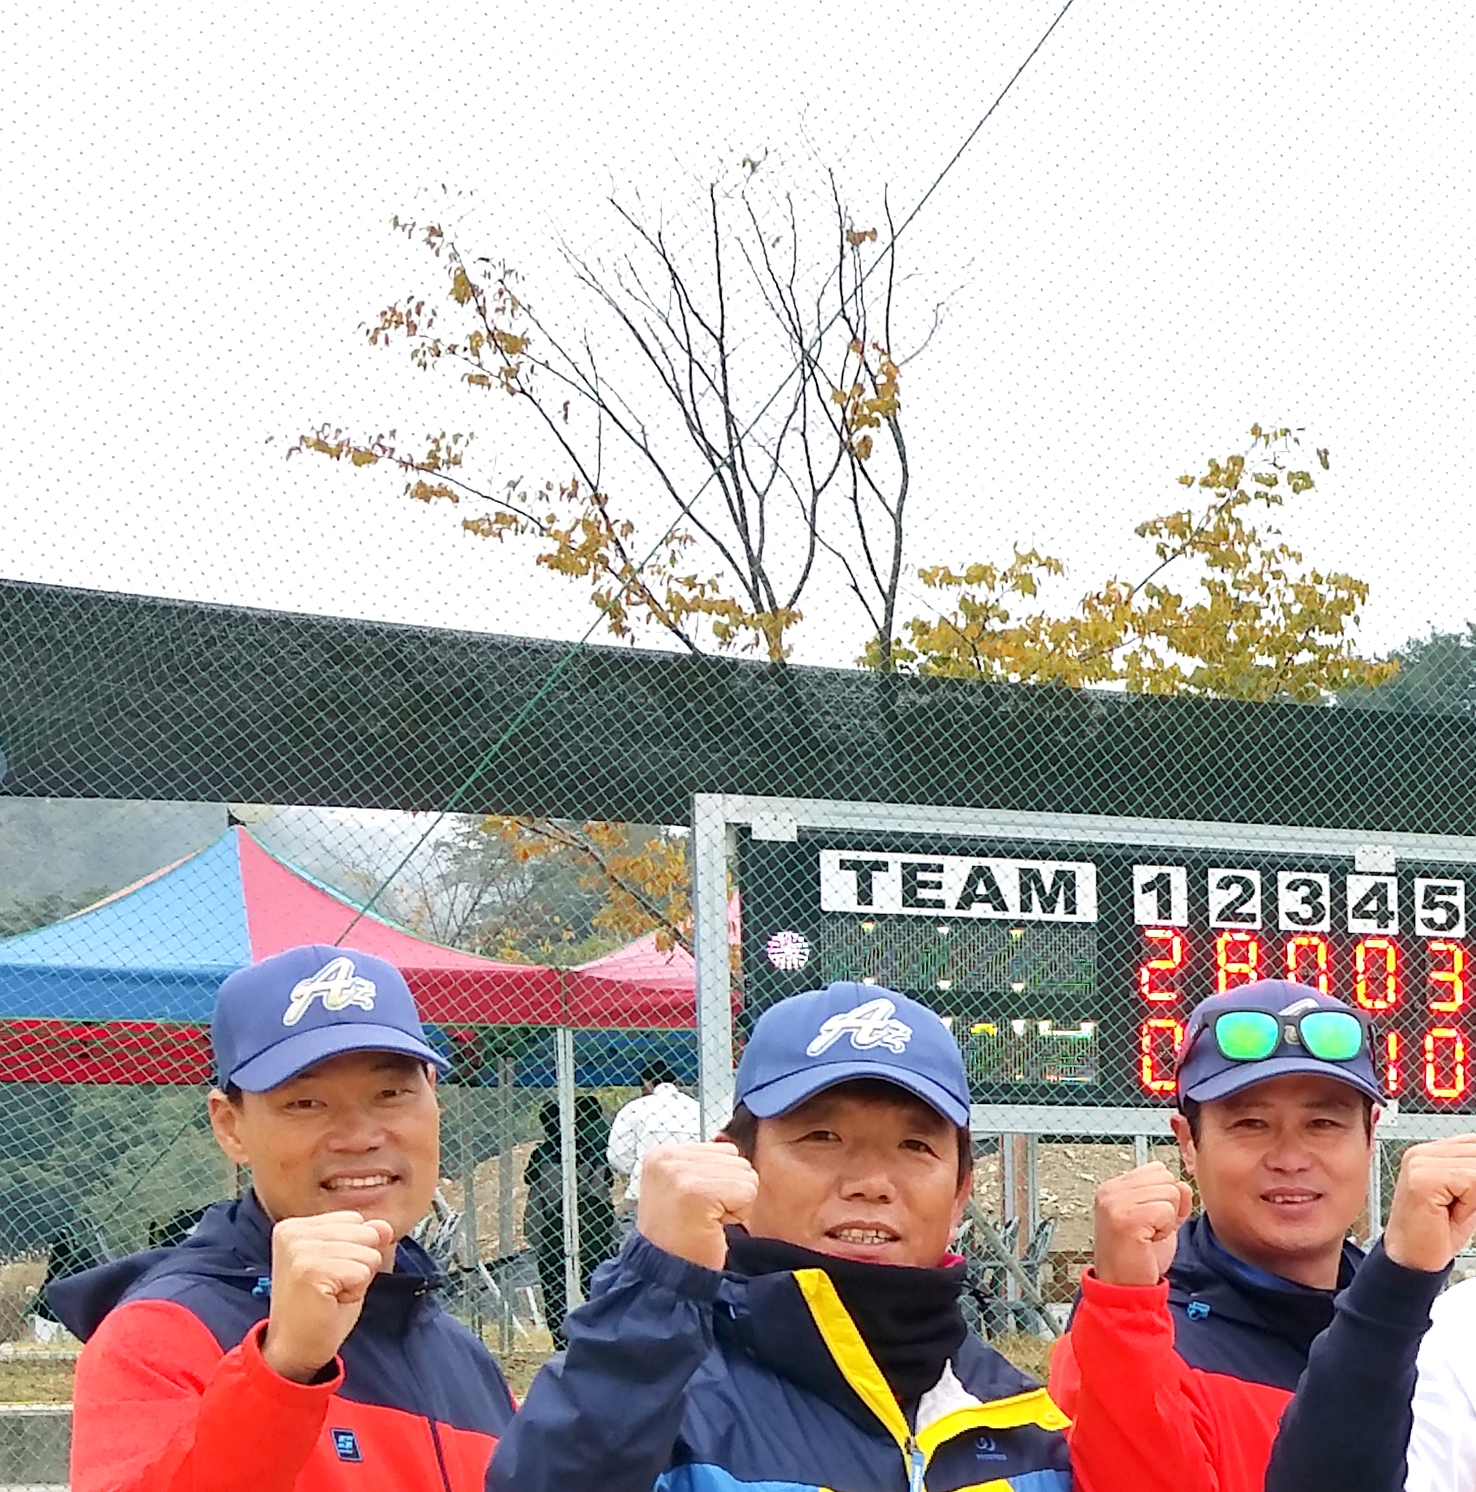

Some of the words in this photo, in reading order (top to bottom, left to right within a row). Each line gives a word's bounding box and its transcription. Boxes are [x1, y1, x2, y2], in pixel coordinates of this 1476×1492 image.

[839, 859, 1077, 915] TEAM
[1140, 873, 1173, 921] 1
[1216, 874, 1256, 923] 2
[1285, 879, 1326, 927] 3
[1352, 882, 1395, 930] 4
[1420, 885, 1460, 932] 5
[1140, 929, 1182, 1001] 2
[1356, 939, 1396, 1009] 0
[1428, 941, 1464, 1012] 3
